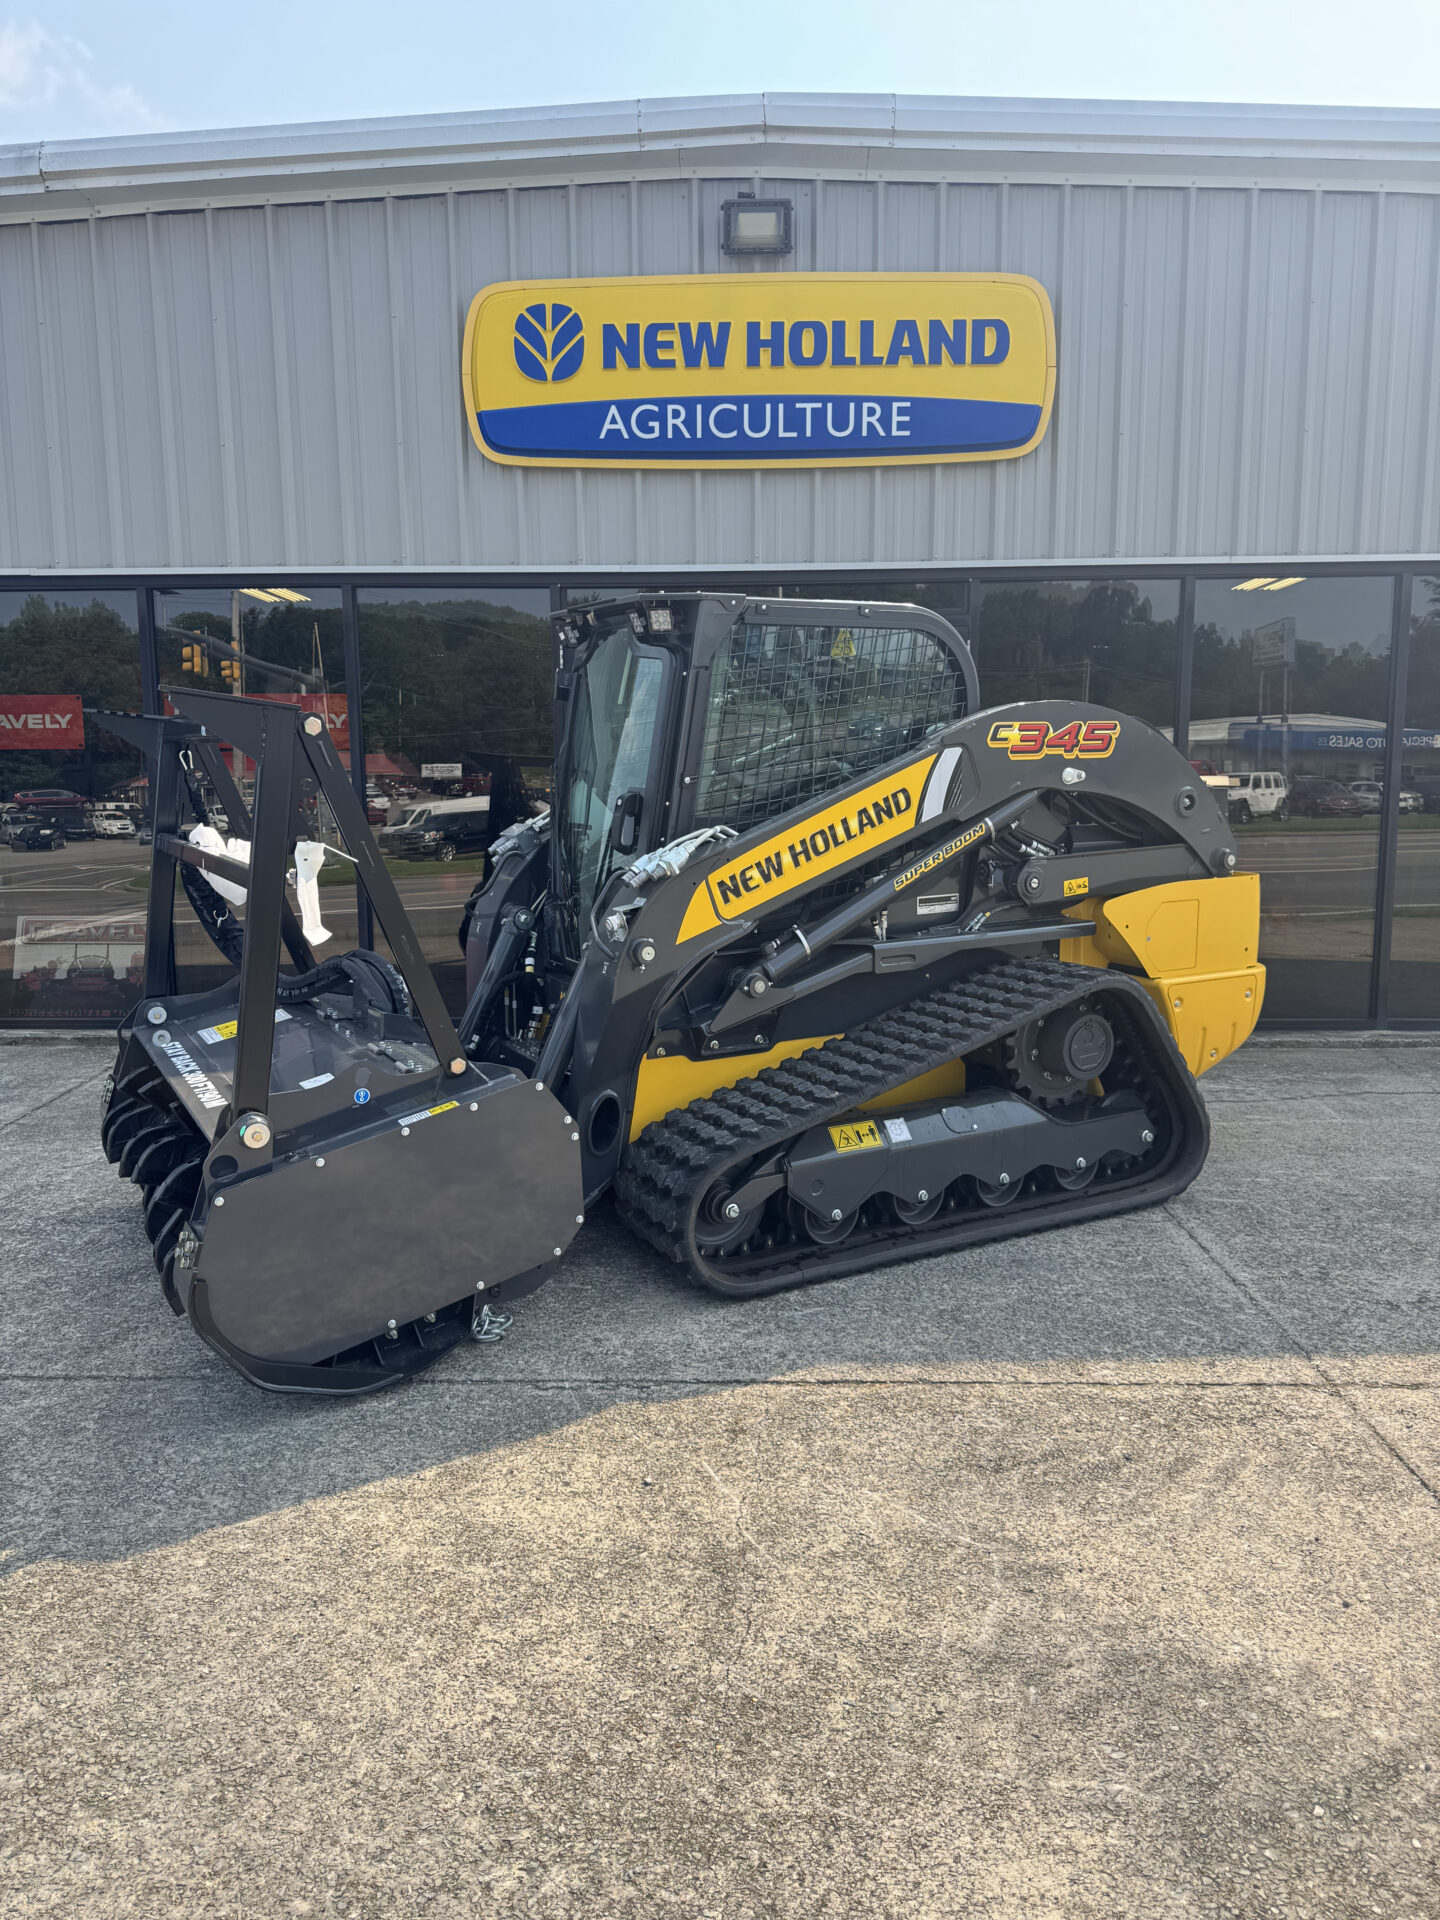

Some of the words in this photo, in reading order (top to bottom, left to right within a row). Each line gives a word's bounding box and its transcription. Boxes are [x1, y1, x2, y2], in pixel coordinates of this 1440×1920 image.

[602, 321, 732, 369] NEW
[746, 318, 1011, 368] HOLLAND
[599, 401, 911, 439] AGRICULTURE
[987, 721, 1120, 760] C345
[717, 850, 785, 906] NEW
[788, 787, 912, 869] HOLLAND
[894, 852, 942, 891] SUPER
[942, 823, 986, 857] BOOM
[161, 1041, 188, 1057] STAY
[170, 1054, 200, 1074] BACK
[182, 1070, 208, 1084] 300
